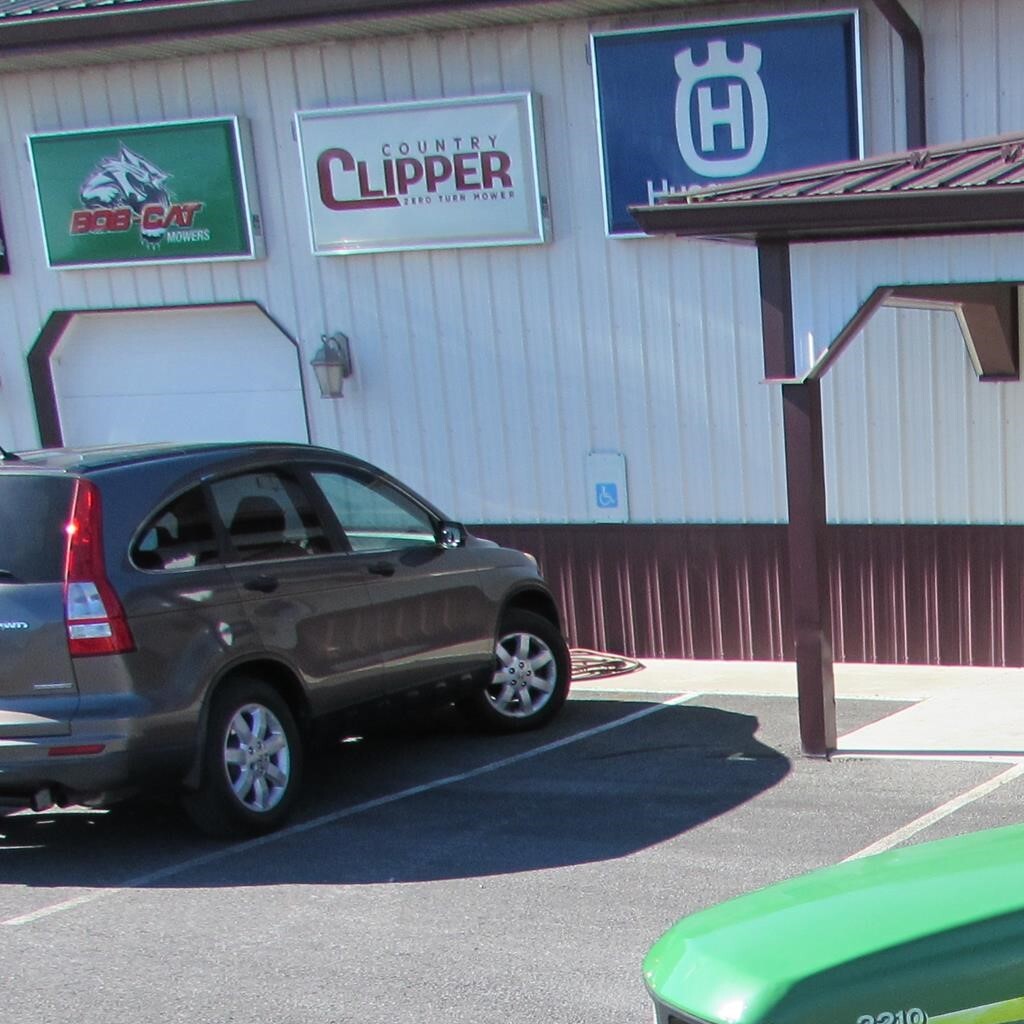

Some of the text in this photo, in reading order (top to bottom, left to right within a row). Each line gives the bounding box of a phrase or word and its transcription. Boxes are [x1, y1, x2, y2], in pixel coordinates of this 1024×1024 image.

[382, 135, 498, 156] COUNTRY
[317, 148, 513, 211] CLIPPER
[404, 190, 515, 206] ZERO TURN MOWER
[70, 202, 206, 236] BOB-CAT
[166, 228, 210, 244] MOWERS
